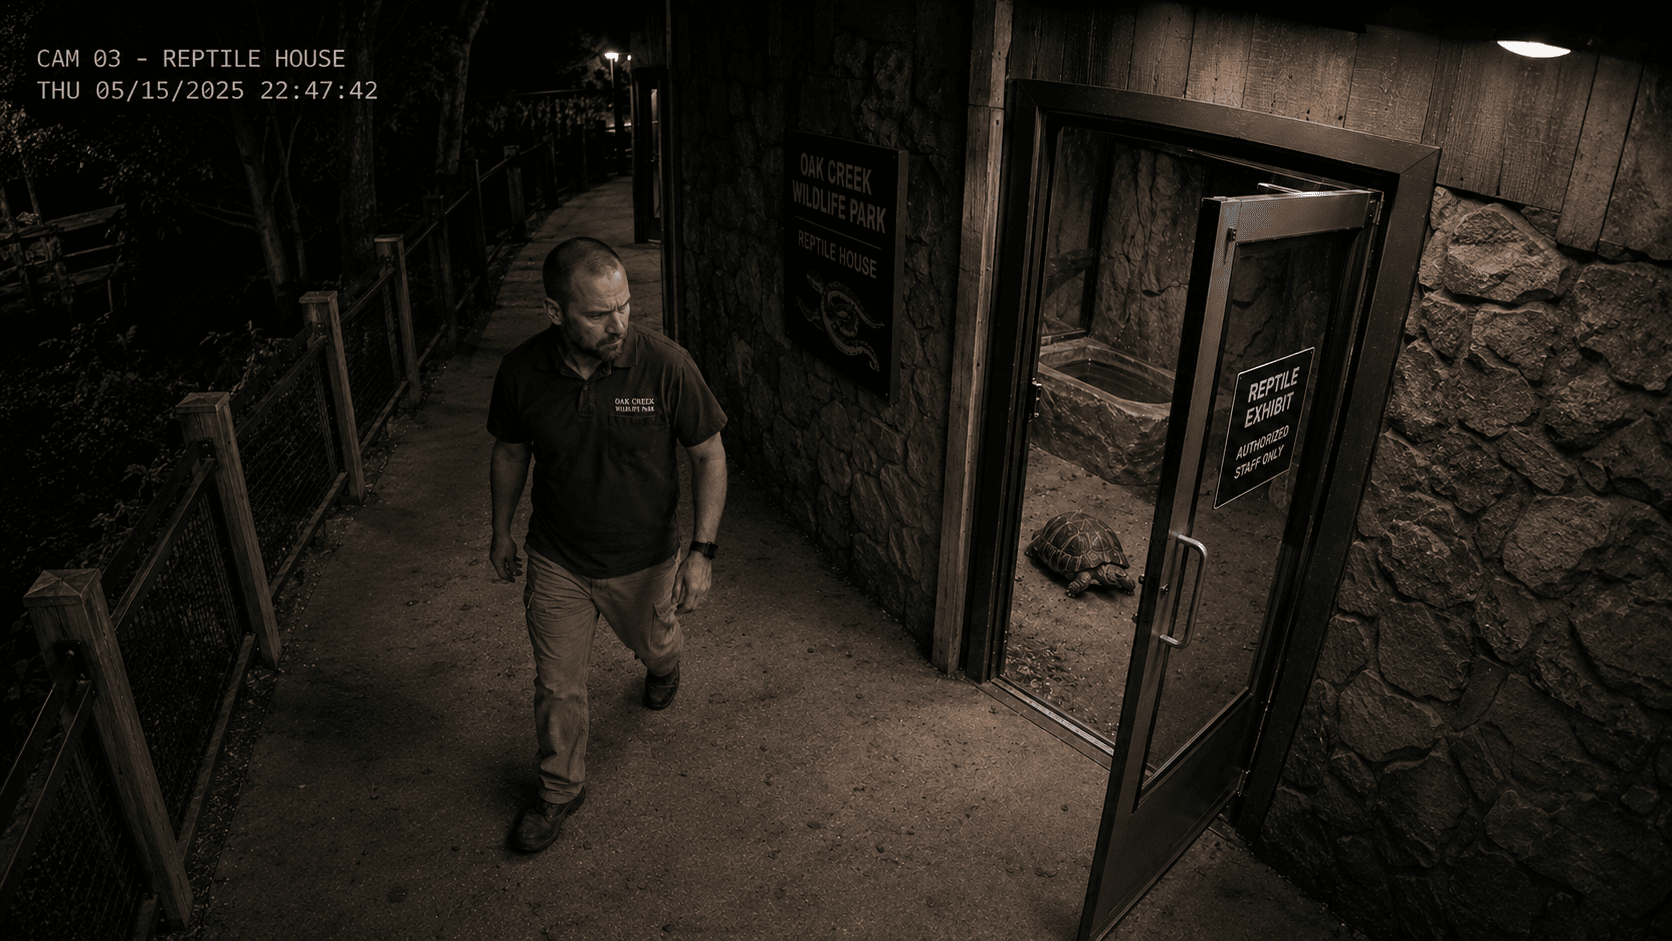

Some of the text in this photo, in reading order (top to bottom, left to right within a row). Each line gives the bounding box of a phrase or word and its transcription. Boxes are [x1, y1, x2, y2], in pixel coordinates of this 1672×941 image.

[800, 152, 872, 196] OAK CREEK
[792, 179, 887, 234] WILDLIFE PARK
[798, 229, 877, 279] REPTILE HOUSE
[1247, 366, 1301, 403] REPTILE
[1244, 391, 1295, 429] EXHIBIT
[1235, 424, 1290, 461] AUTHORIZED
[1233, 444, 1285, 480] STAFF ONLY
